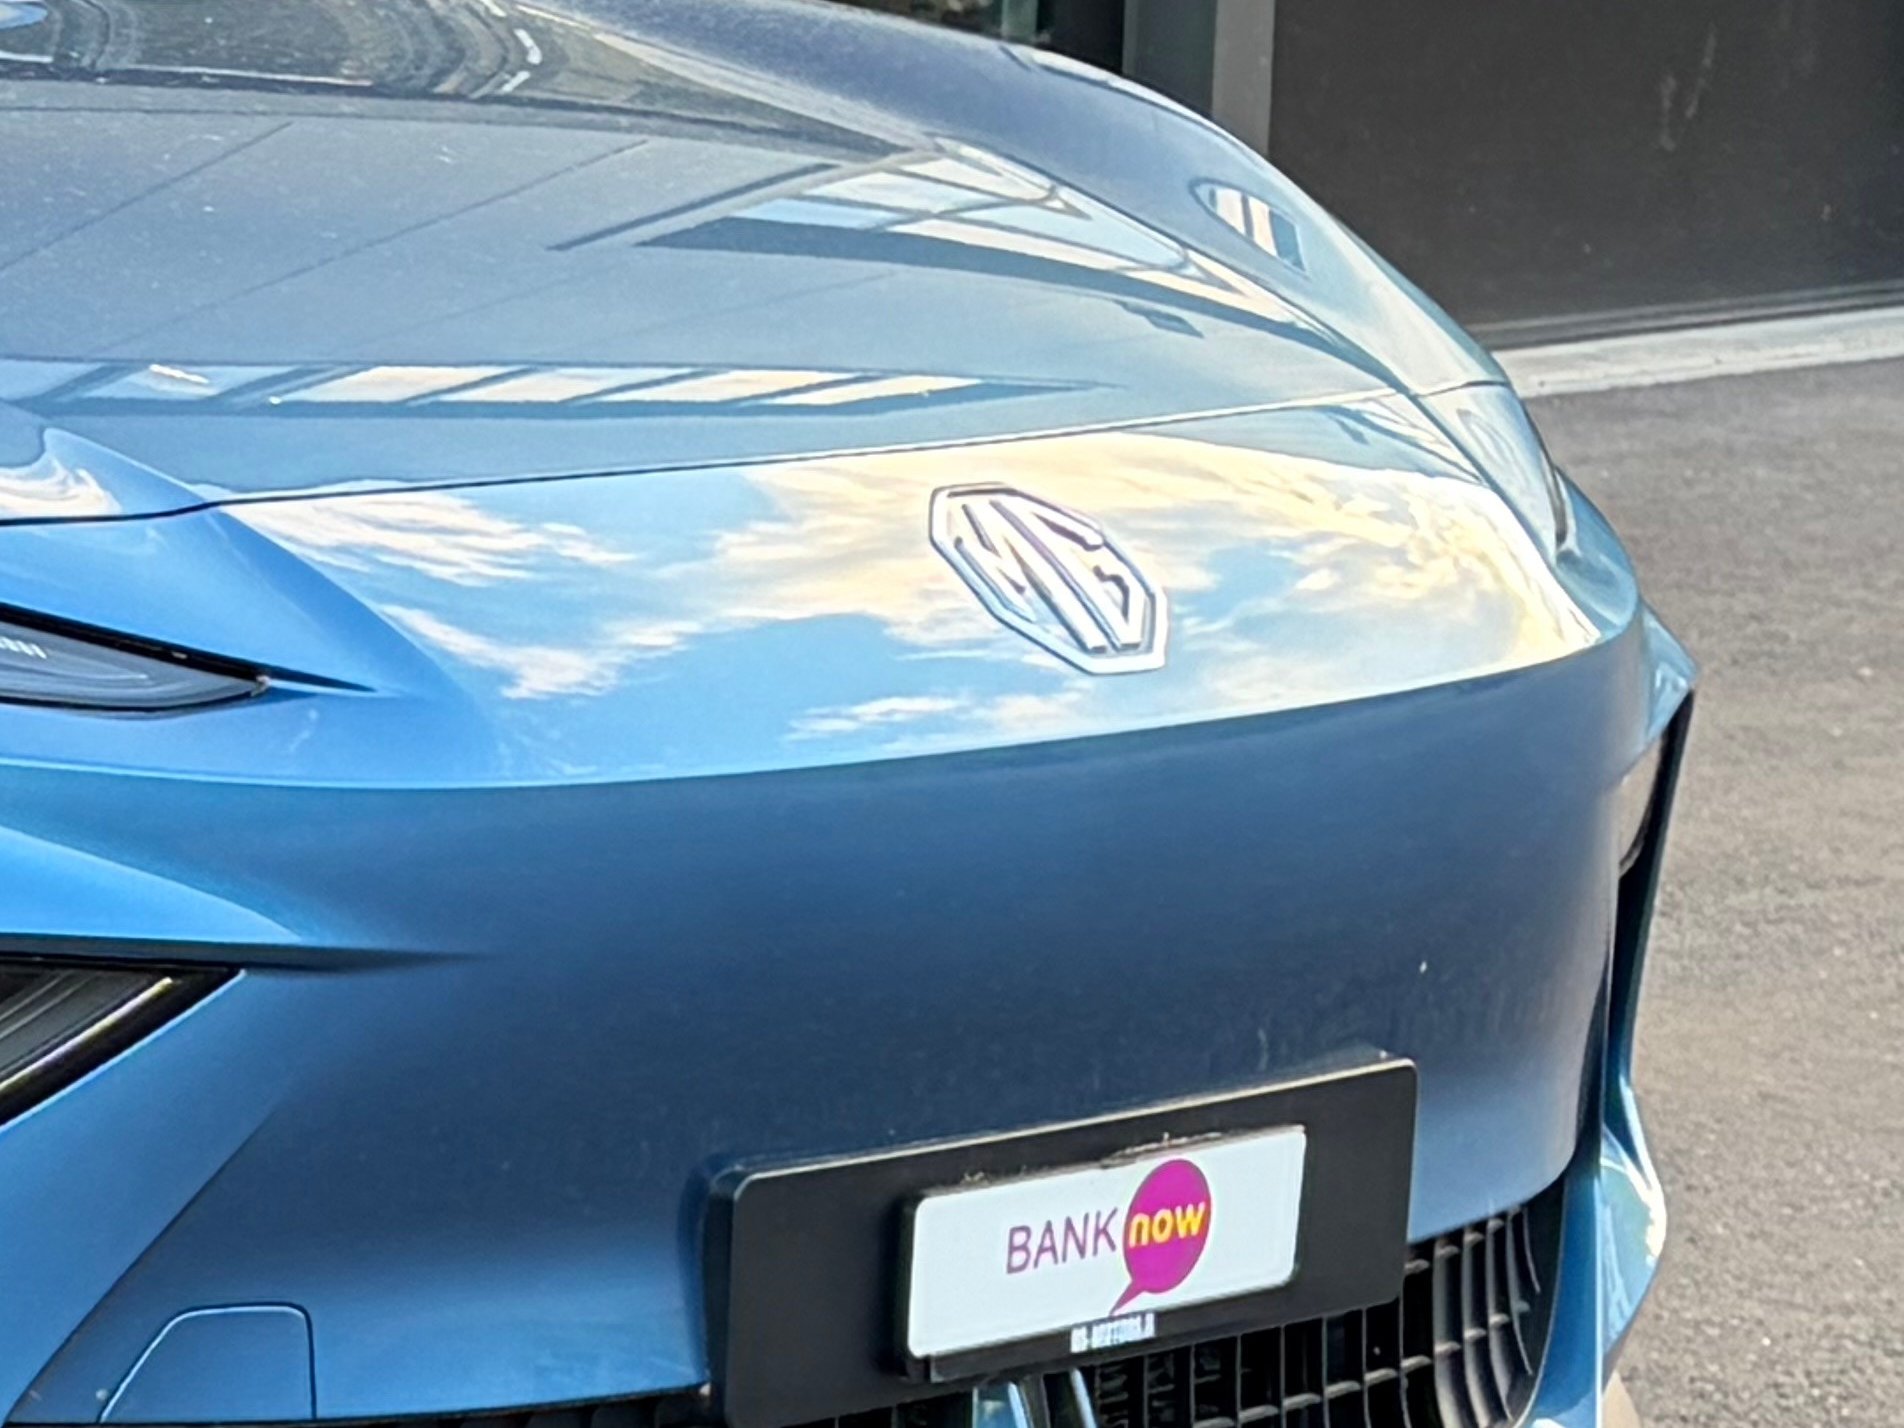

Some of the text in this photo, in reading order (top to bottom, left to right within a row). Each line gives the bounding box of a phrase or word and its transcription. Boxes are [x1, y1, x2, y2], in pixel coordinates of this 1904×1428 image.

[941, 492, 1149, 659] MG
[1005, 1201, 1207, 1275] BANK now
